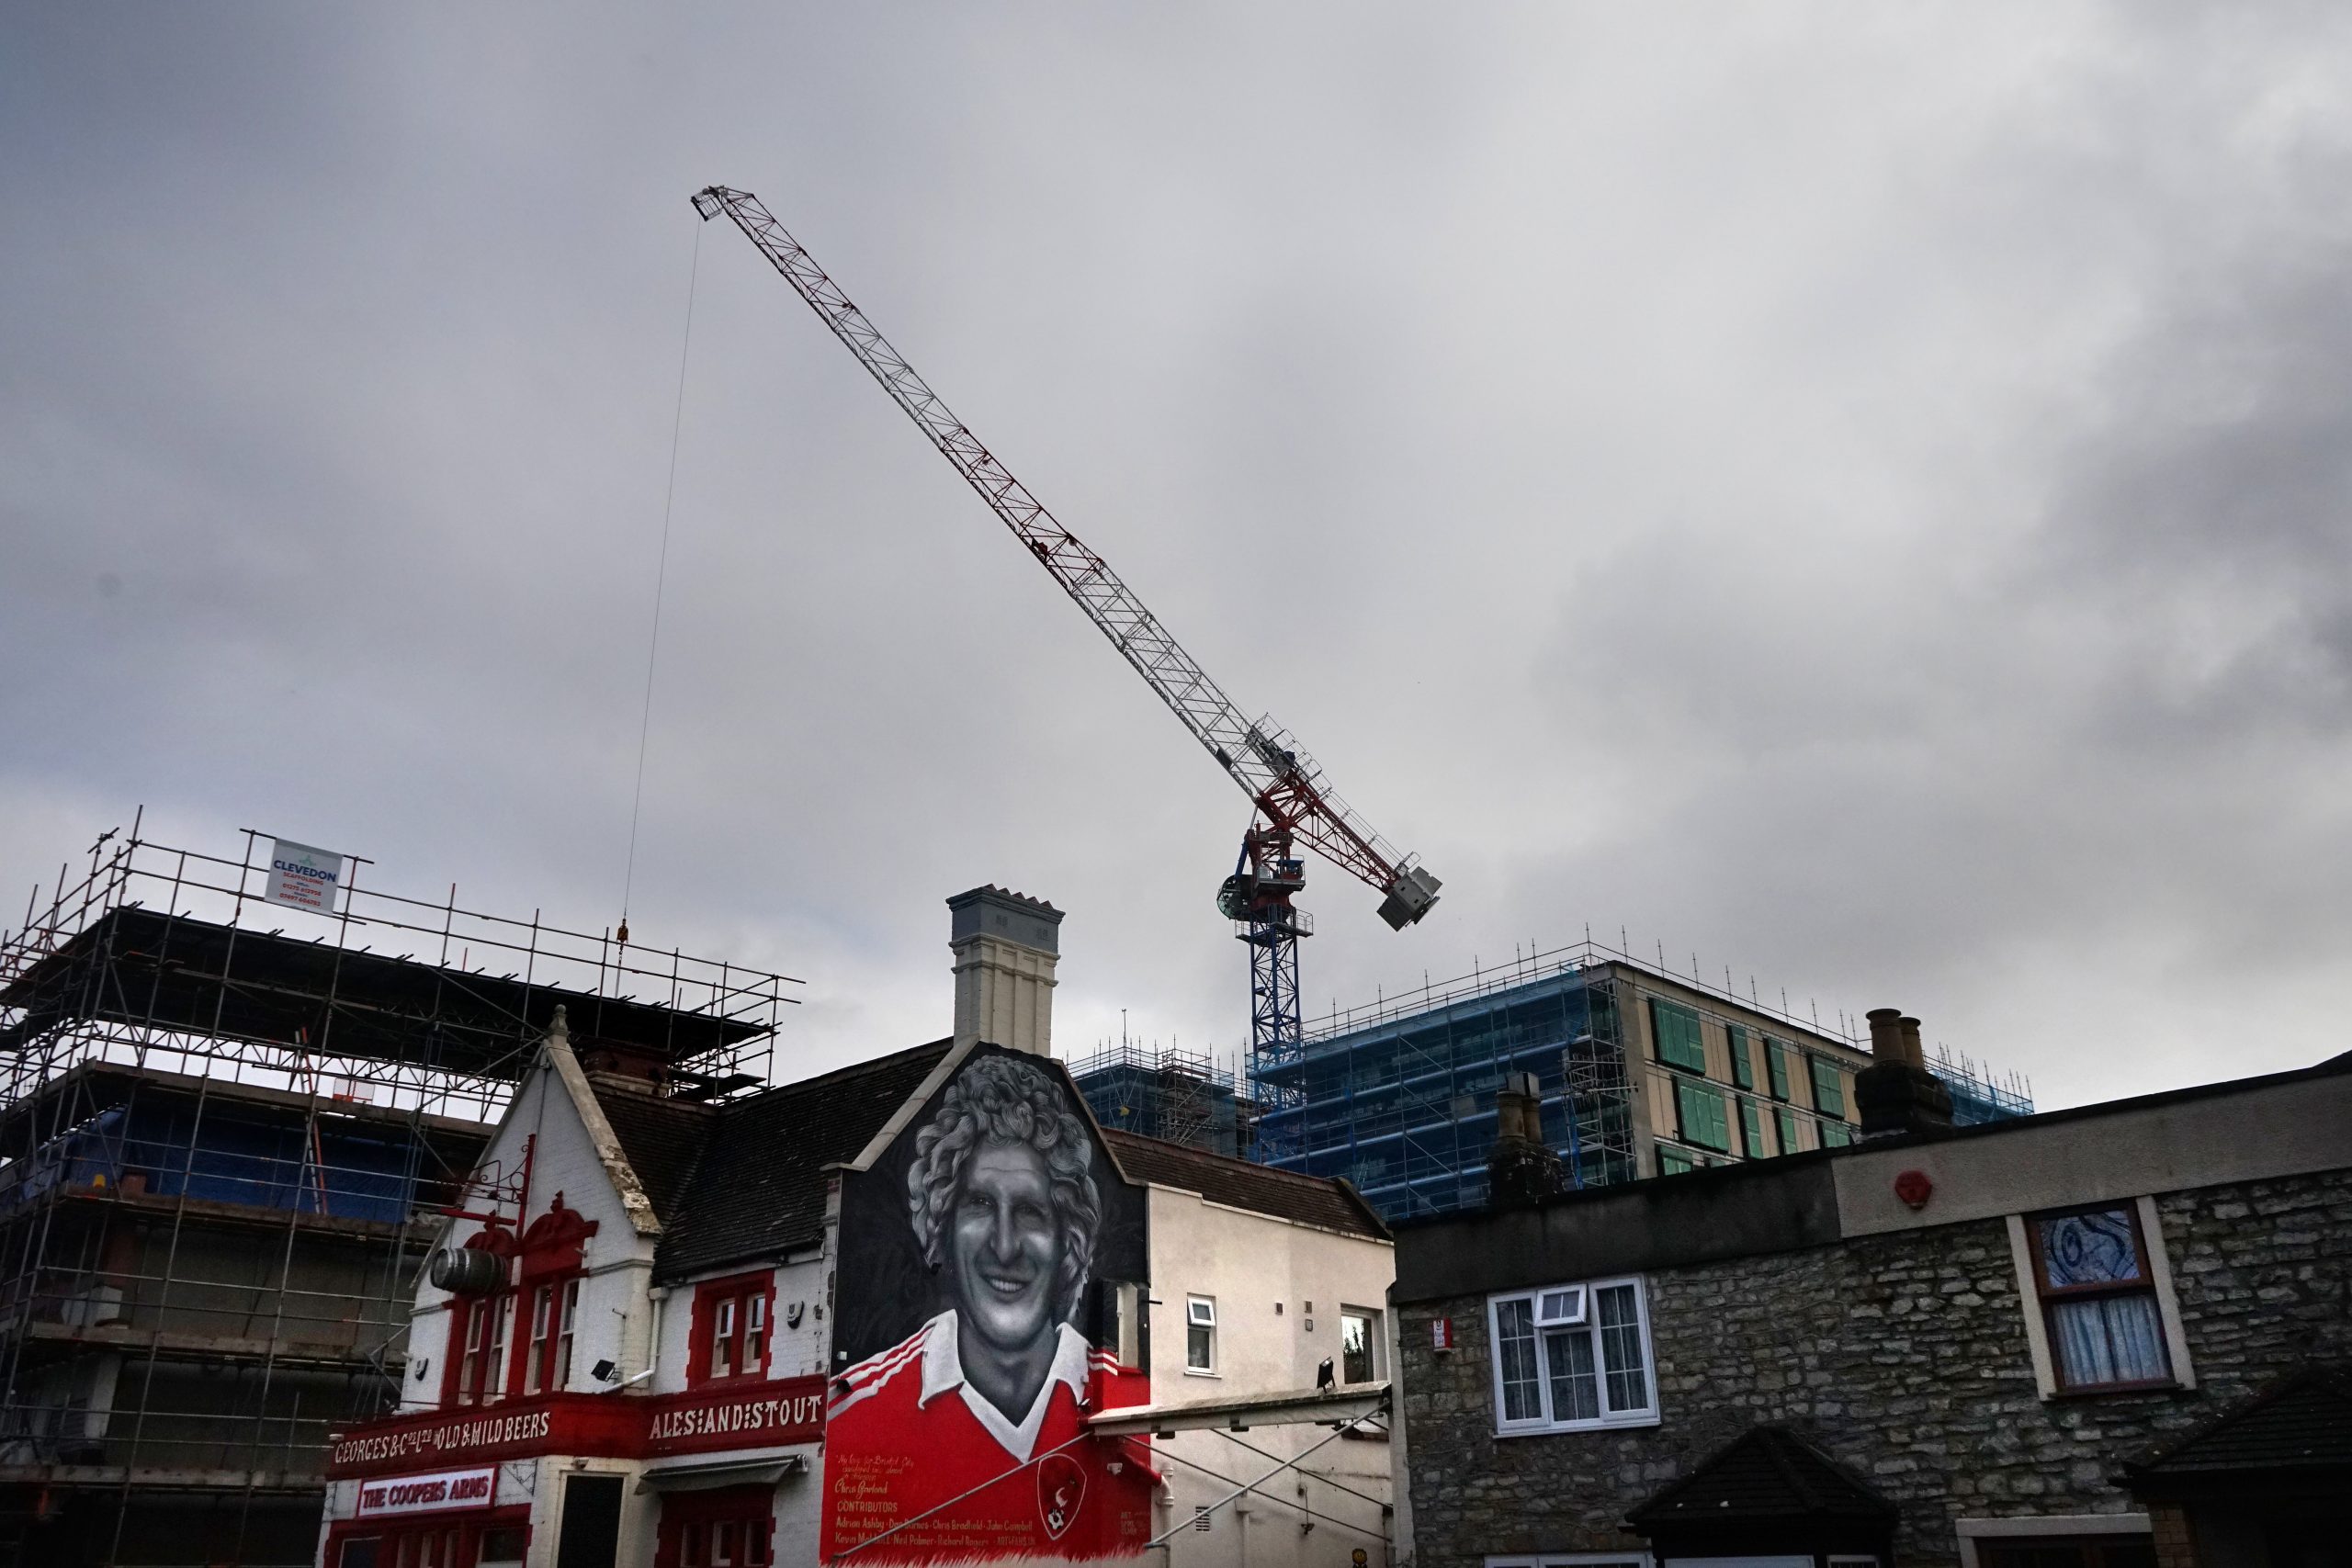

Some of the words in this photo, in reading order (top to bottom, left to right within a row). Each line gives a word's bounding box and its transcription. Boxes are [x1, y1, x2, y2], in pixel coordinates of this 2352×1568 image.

[274, 860, 336, 882] CLEVEDON
[283, 872, 324, 886] SCAFFOLDING
[750, 1394, 822, 1429] STOUT
[334, 1436, 390, 1464] GEORGES
[436, 1425, 460, 1450] OLD
[470, 1418, 503, 1447] MILD
[503, 1411, 550, 1442] BEERS
[363, 1487, 387, 1508] THE
[388, 1480, 447, 1506] COOPERS
[449, 1475, 490, 1500] ARMS
[834, 1477, 855, 1495] Chris
[837, 1501, 898, 1513] CONTRIBUTORS
[836, 1516, 860, 1529] Adrian
[862, 1517, 885, 1532] Ashby
[933, 1518, 951, 1530] Chris
[835, 1531, 856, 1544] Kevin
